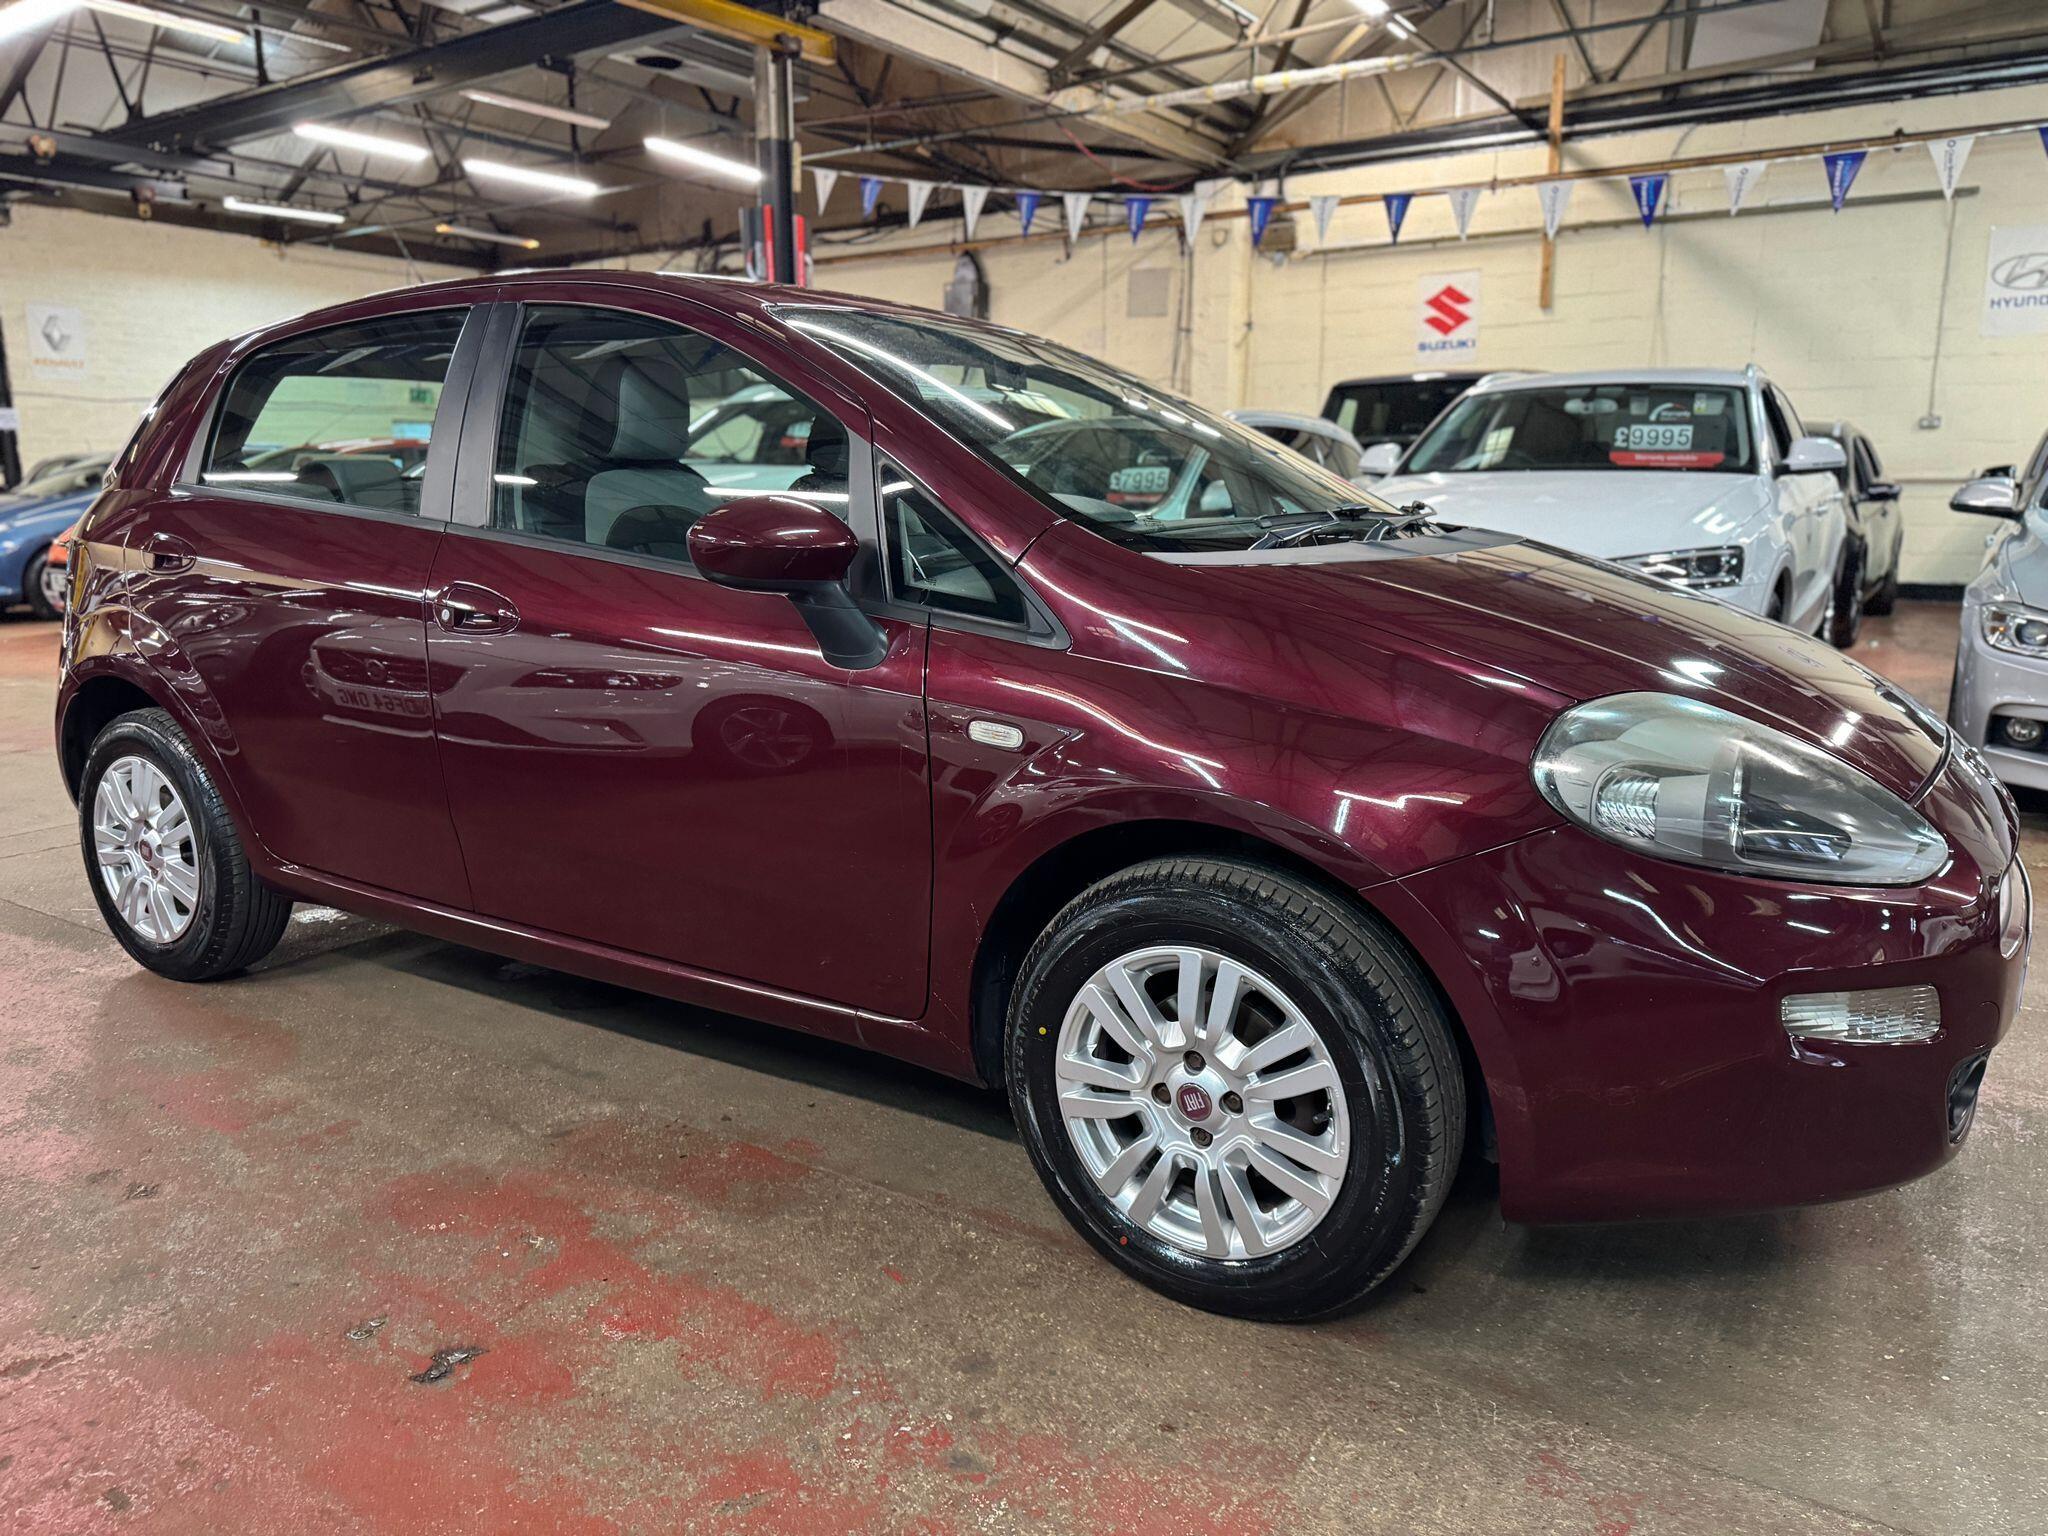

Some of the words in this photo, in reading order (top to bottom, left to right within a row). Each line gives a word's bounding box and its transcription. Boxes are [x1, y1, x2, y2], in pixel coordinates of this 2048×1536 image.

[1418, 339, 1476, 352] SUZUKI
[1614, 427, 1691, 448] £9995
[1183, 1092, 1206, 1112] FIAT
